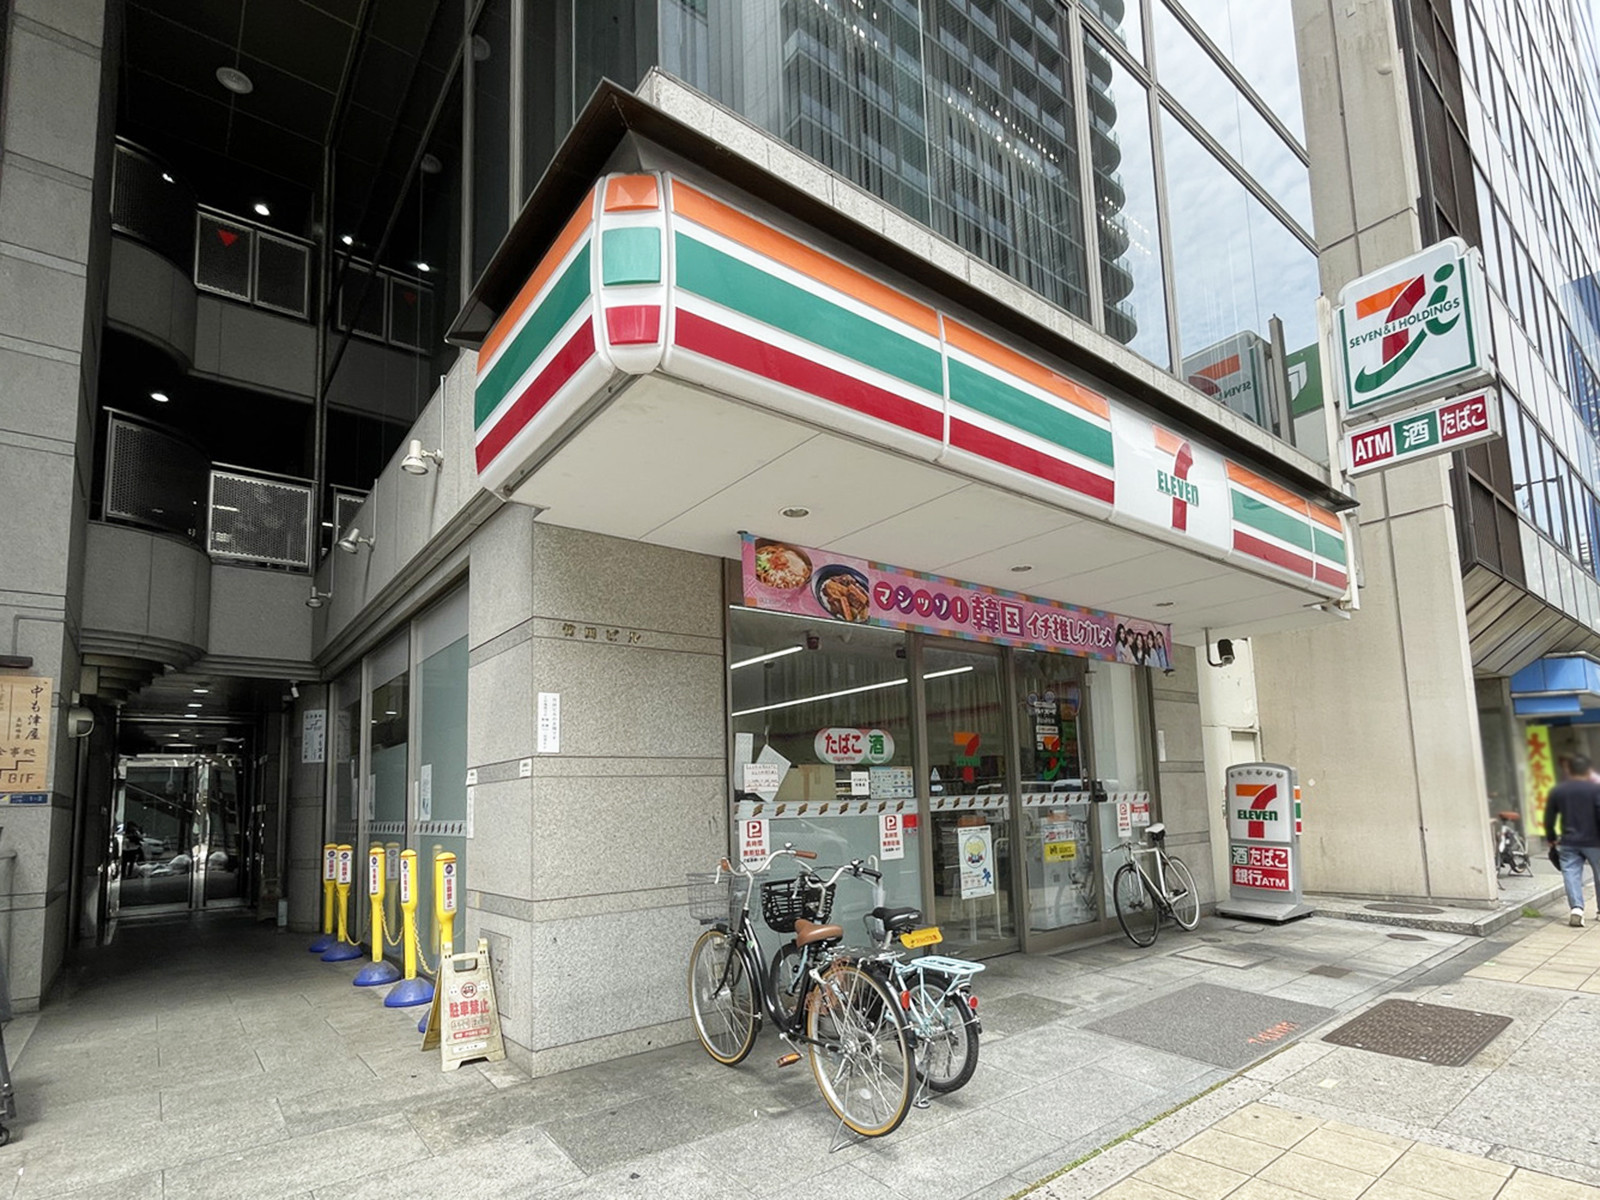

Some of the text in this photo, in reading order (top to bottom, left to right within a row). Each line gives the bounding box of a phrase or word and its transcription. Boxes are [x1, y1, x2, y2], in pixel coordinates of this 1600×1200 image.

[1397, 298, 1460, 330] HOLDINGS
[1355, 405, 1486, 462] ATM 酒 たばこ
[825, 733, 884, 754] たばこ 酒
[1232, 847, 1287, 867] 酒 たばこ
[450, 998, 489, 1018] 駐車禁止
